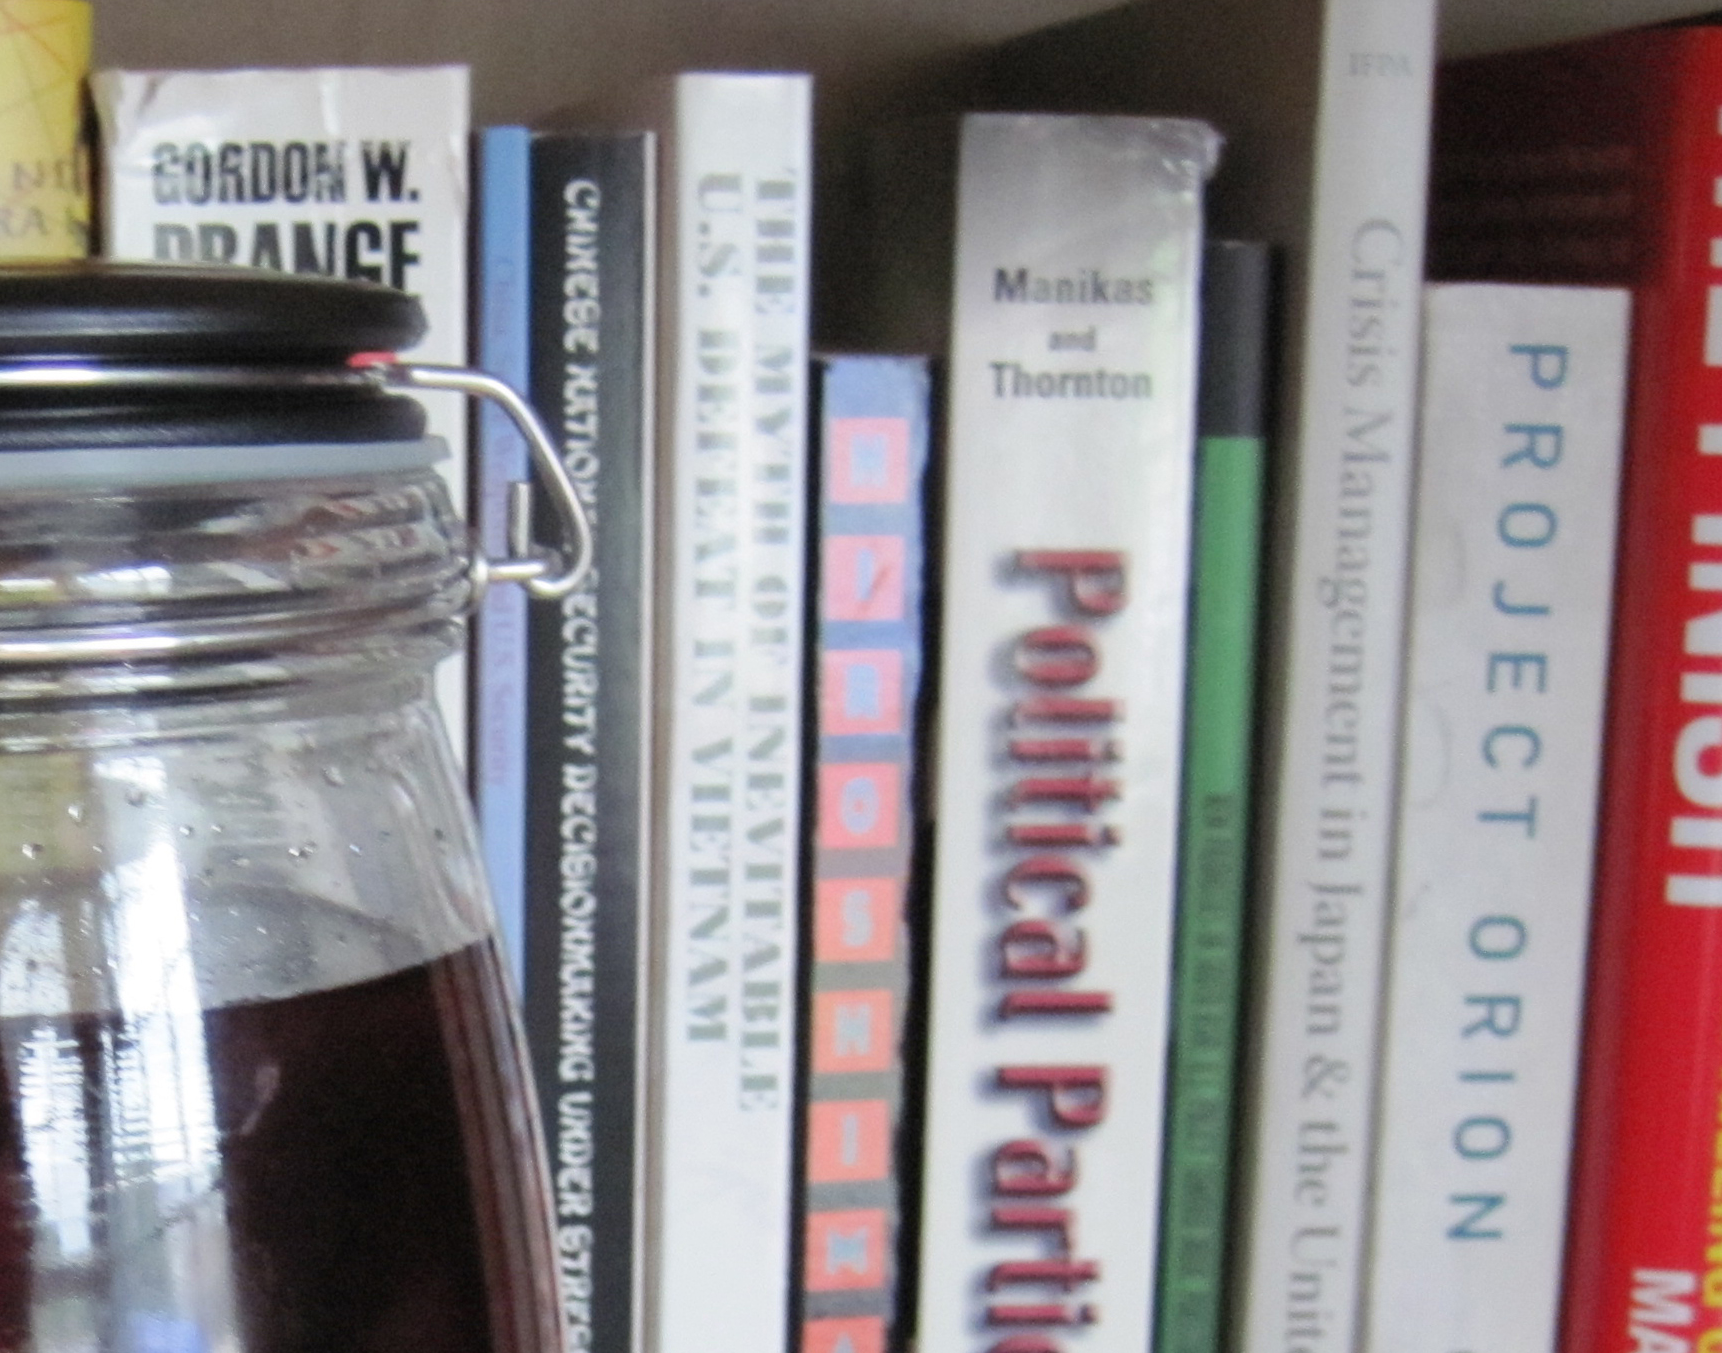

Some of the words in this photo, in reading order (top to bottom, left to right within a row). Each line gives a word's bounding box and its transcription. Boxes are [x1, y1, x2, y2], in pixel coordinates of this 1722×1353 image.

[153, 141, 347, 205] GORDON
[360, 141, 420, 202] W.
[697, 173, 743, 297] U.S.
[756, 165, 796, 314] THE
[563, 178, 601, 353] CHINESE
[994, 267, 1154, 305] Manikas
[1048, 325, 1097, 352] and
[1344, 217, 1404, 389] Crisis
[563, 366, 599, 526] NATION
[989, 361, 1153, 399] Thornton
[1318, 405, 1393, 788] Management
[1477, 343, 1570, 839] PROJECT
[992, 549, 1129, 1024] Political
[1317, 809, 1369, 861] in
[686, 737, 734, 1043] VIETNAM
[1296, 881, 1364, 1037] Japan
[1301, 1054, 1351, 1099] &
[1445, 914, 1528, 1242] ORION
[557, 1090, 595, 1218] UNDER
[1293, 1120, 1349, 1207] the
